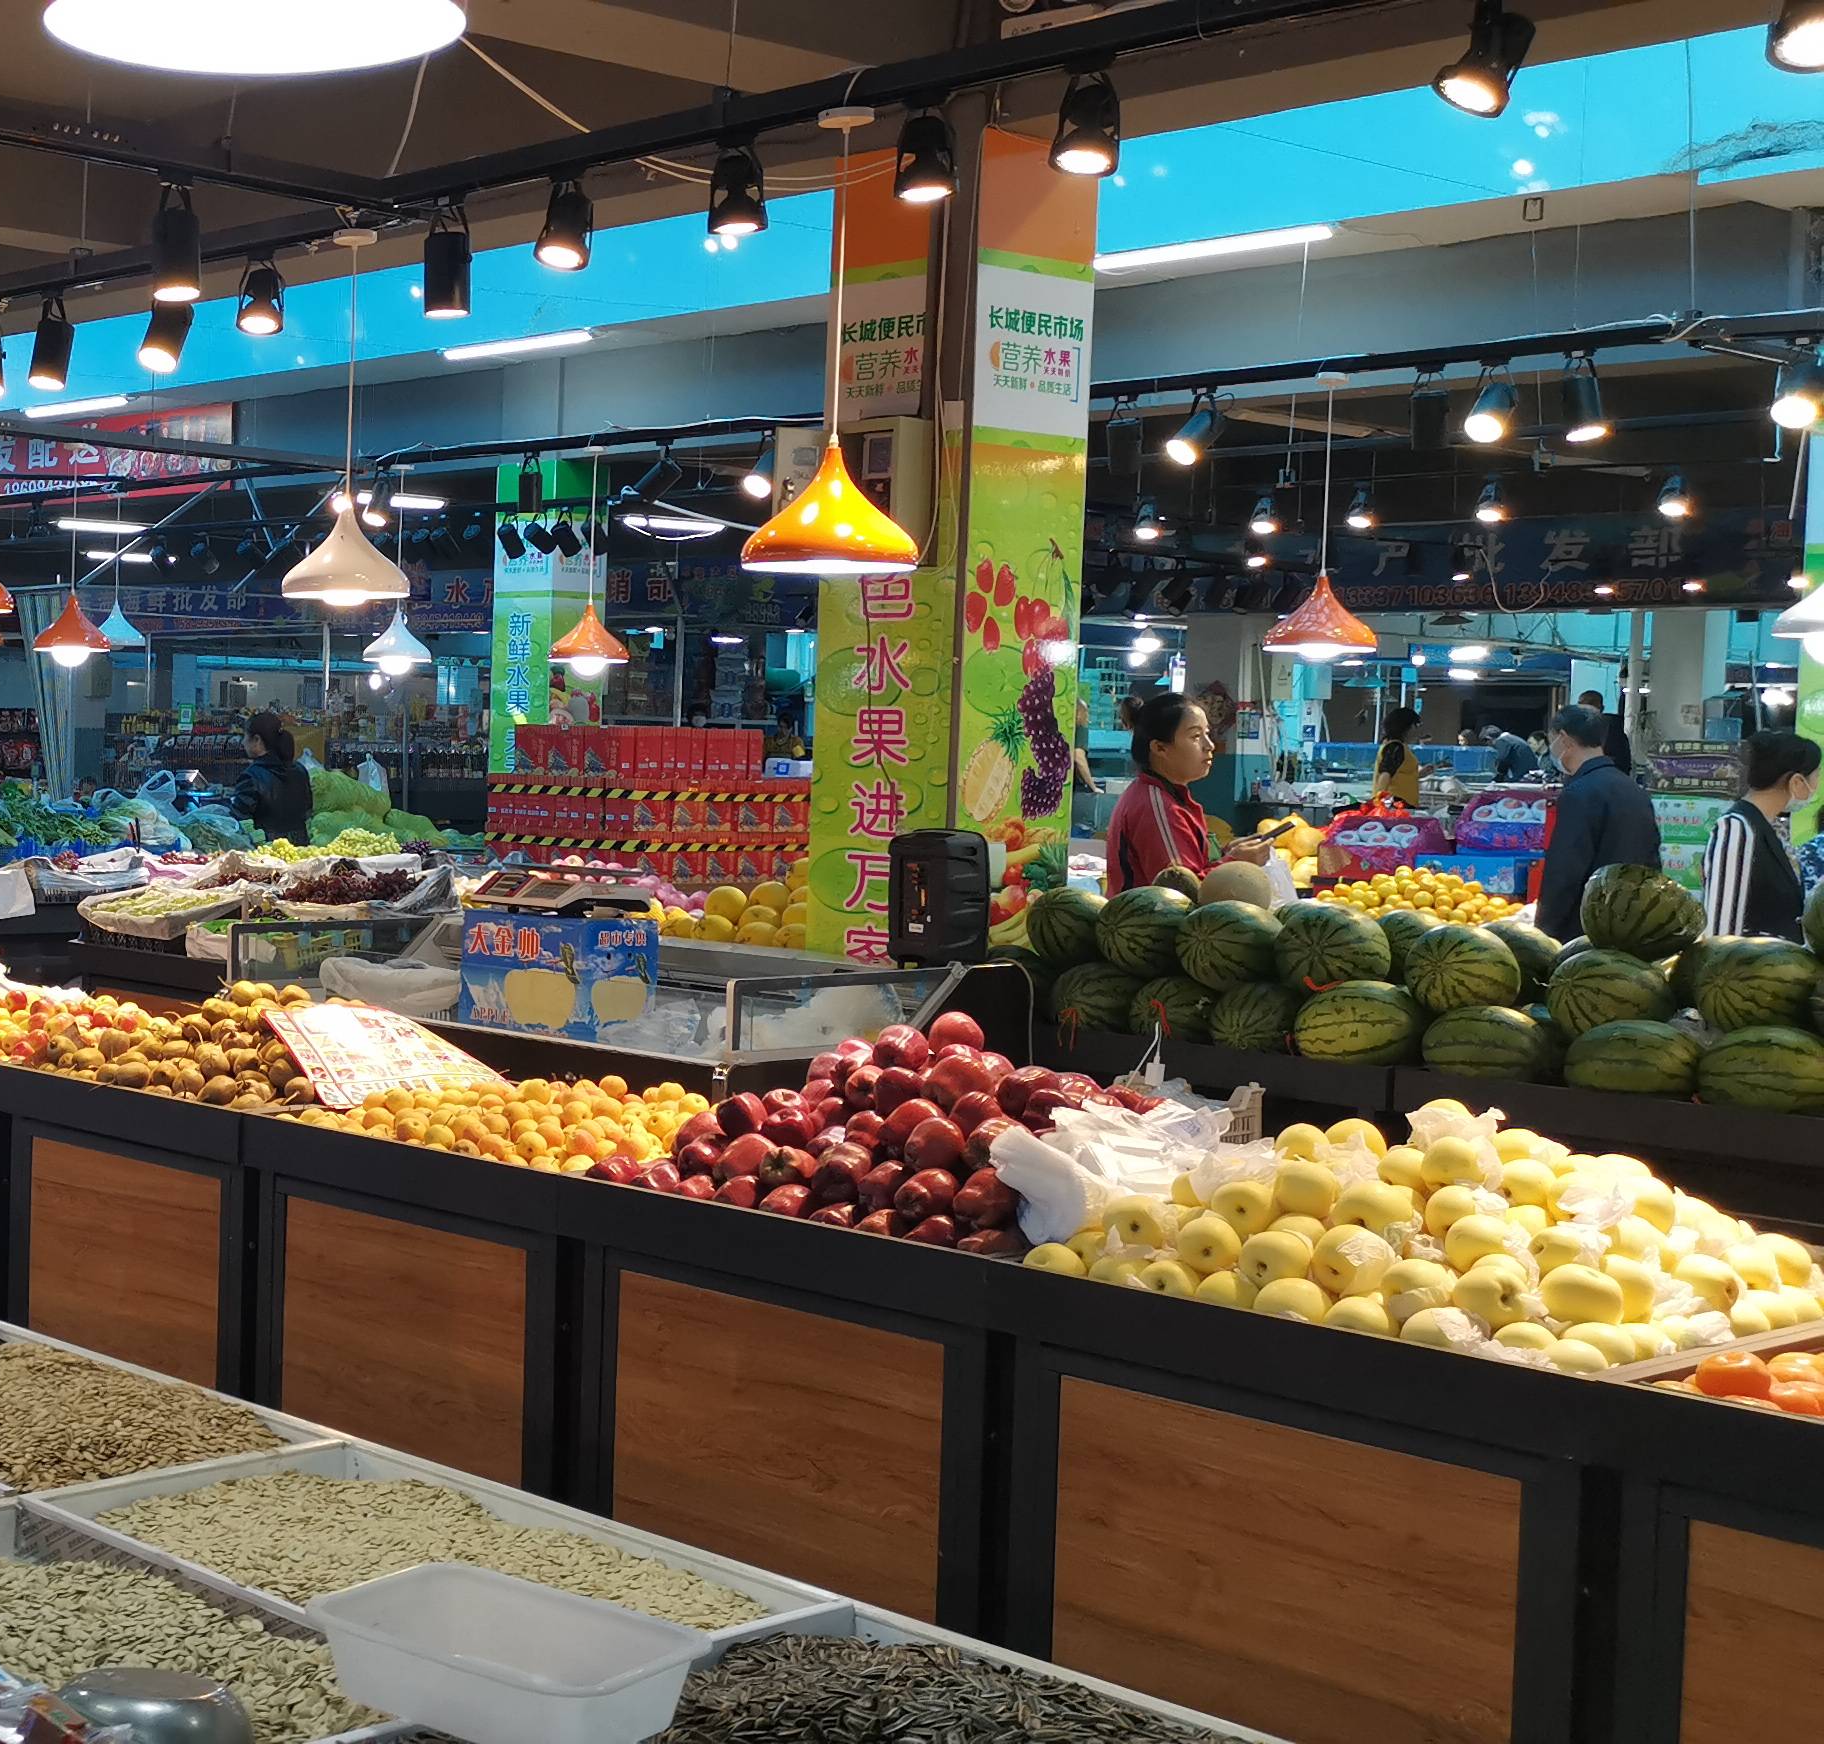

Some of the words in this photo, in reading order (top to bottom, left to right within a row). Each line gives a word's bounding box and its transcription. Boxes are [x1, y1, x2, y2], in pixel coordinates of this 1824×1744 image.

[989, 305, 1084, 342] 长城便民市场
[855, 348, 902, 381] 营养
[903, 346, 919, 364] 水
[1001, 341, 1042, 375] 营养
[1043, 347, 1071, 367] 水果
[993, 374, 1028, 390] 天天新鲜
[506, 612, 532, 714] 新鲜水果
[468, 922, 540, 961] 大金帅
[598, 929, 648, 948] 超市专供
